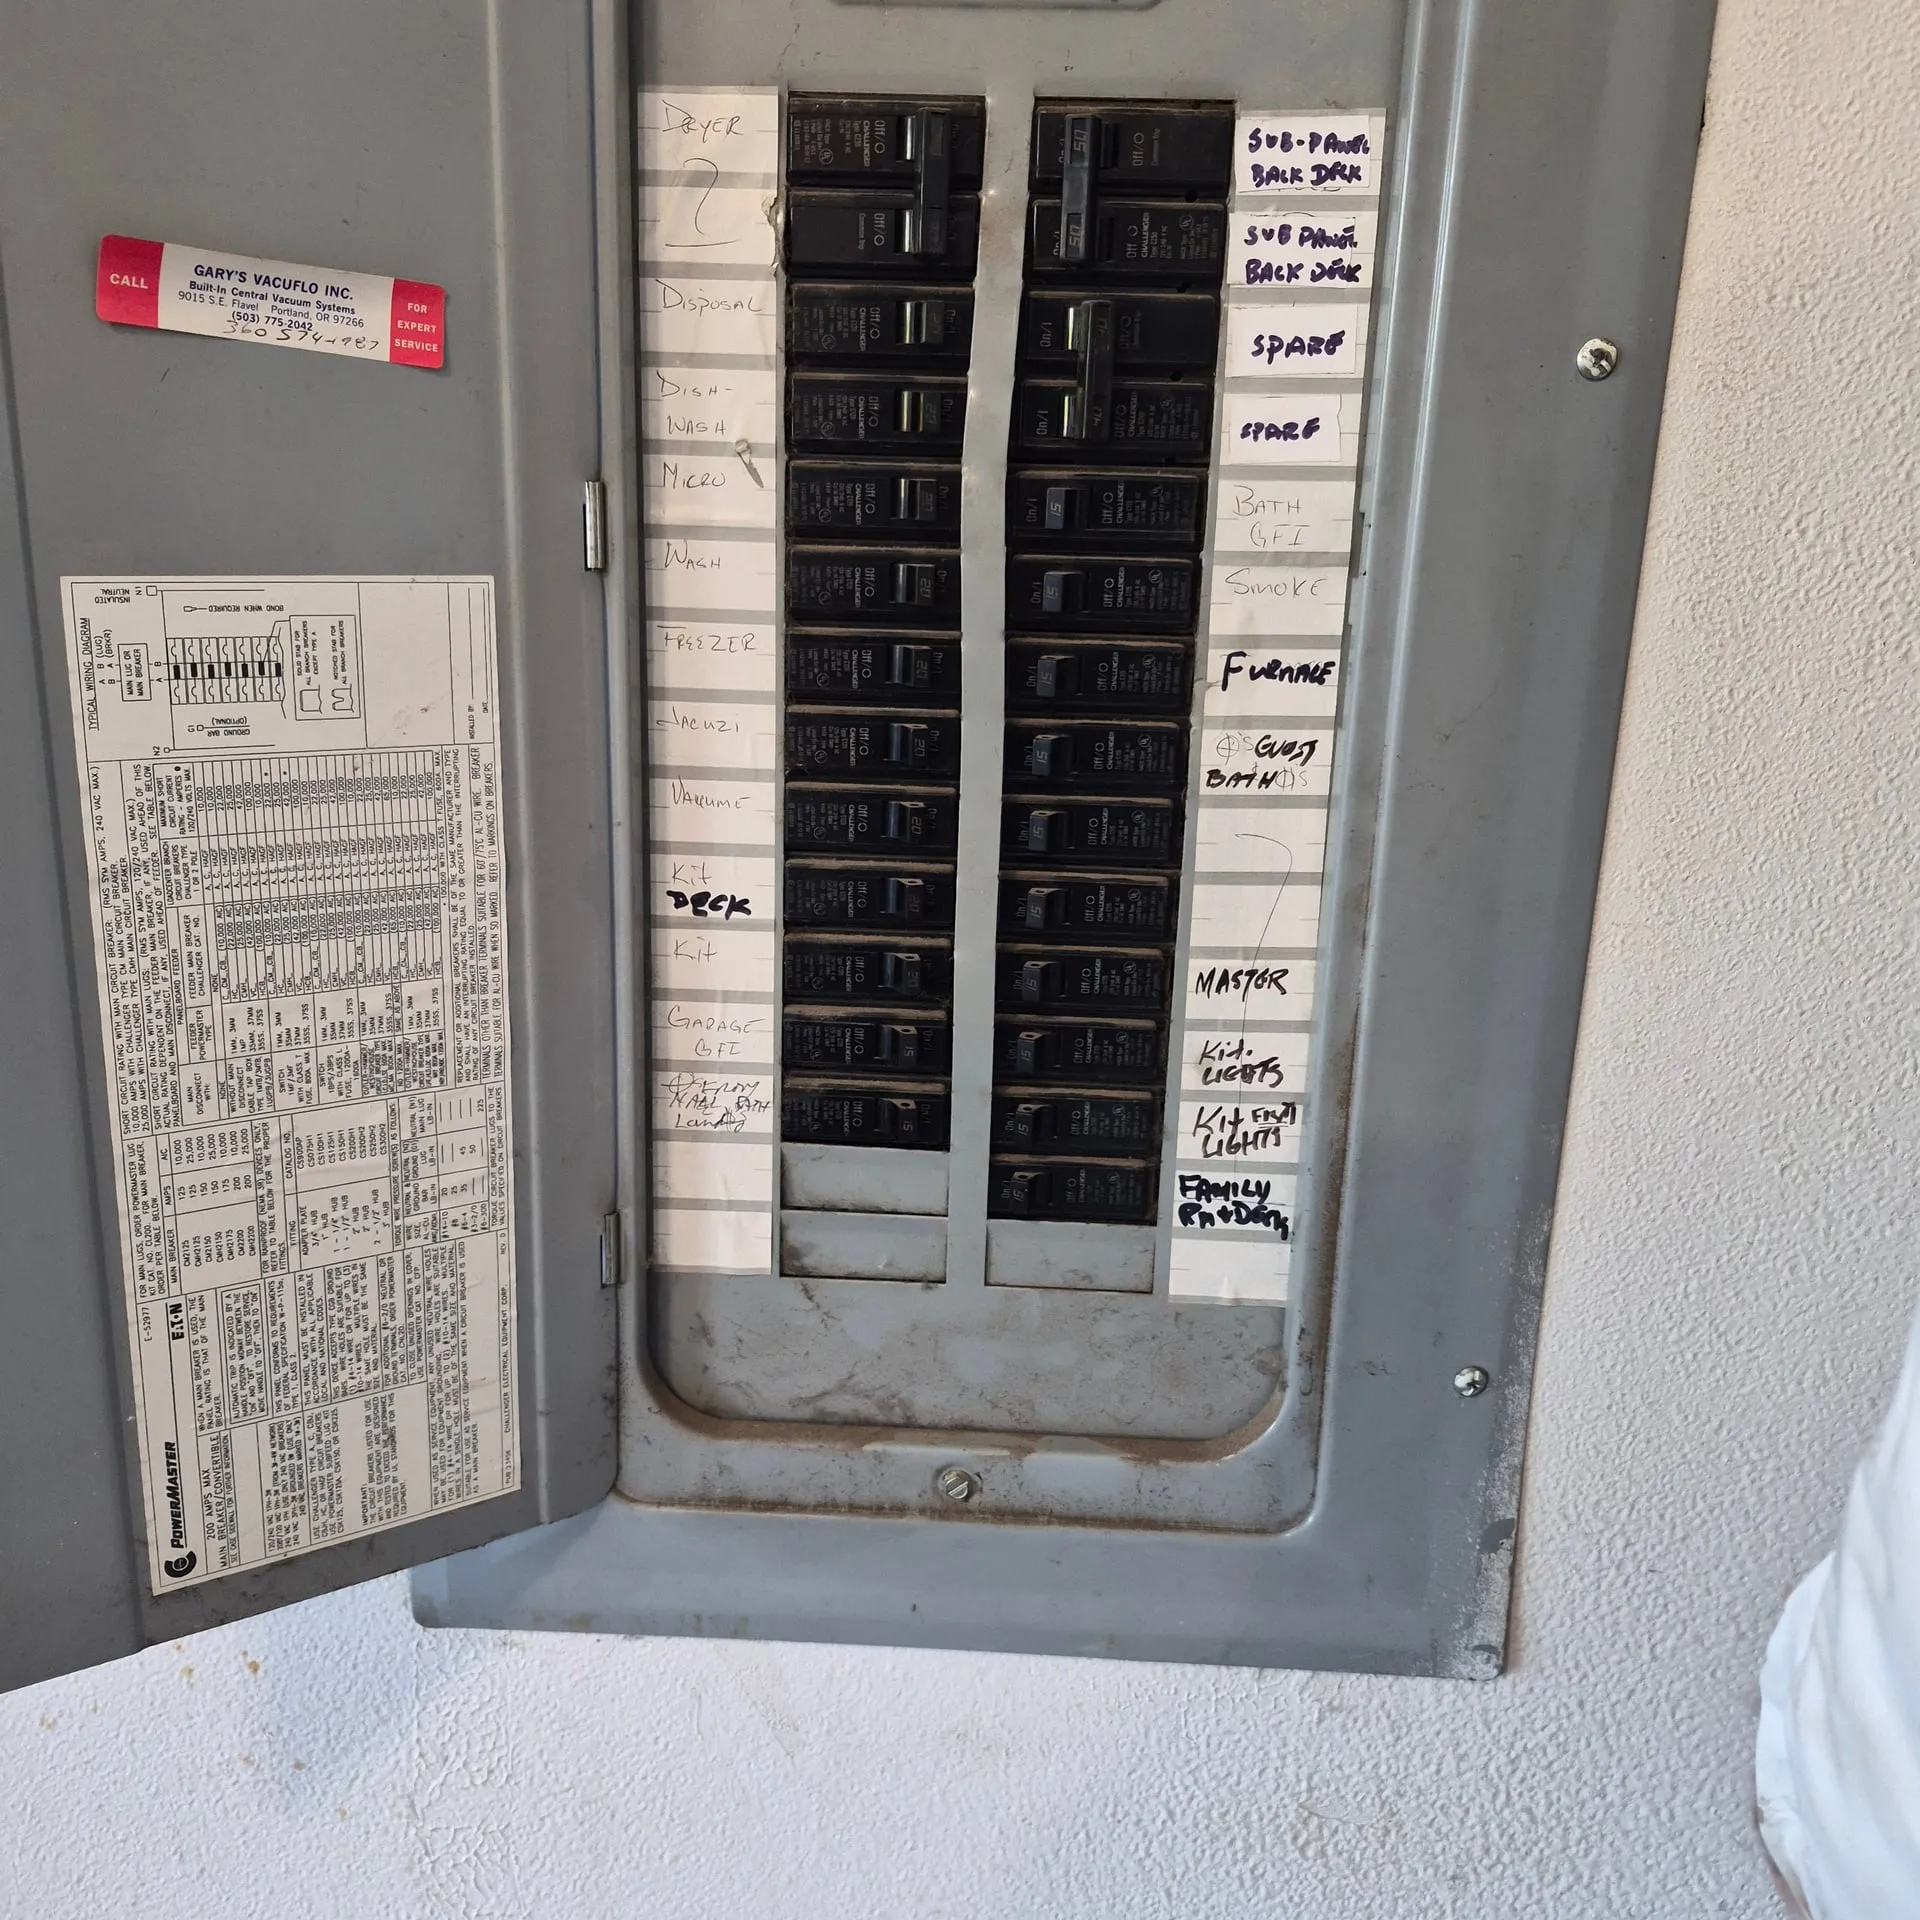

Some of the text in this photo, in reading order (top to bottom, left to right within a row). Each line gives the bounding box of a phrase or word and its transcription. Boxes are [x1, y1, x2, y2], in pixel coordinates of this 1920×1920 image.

[662, 99, 743, 143] DRYER
[1073, 129, 1088, 151] 50
[1251, 161, 1362, 188] BACK DECK
[1069, 224, 1081, 248] 50
[1244, 224, 1292, 246] SUB
[1298, 225, 1358, 249] PANEL
[109, 273, 148, 289] CALL
[194, 264, 353, 300] GARY'S VACUFLO INC.
[1245, 258, 1362, 284] BACK DECK
[178, 290, 364, 328] 9015 S.E. Flavel Portland, OR 97266
[189, 281, 356, 315] Built-In Central Vacuum Systems
[407, 303, 427, 314] FOR
[223, 320, 267, 337] 360
[232, 311, 313, 332] (503) 775-2042
[397, 320, 437, 335] EXPERT
[394, 338, 439, 352] SERVICE
[1251, 330, 1346, 365] SPARE
[667, 415, 726, 435] WASH
[1240, 417, 1320, 442] SPARE
[663, 461, 726, 489] MICRO
[1050, 501, 1062, 516] 15
[1232, 485, 1302, 517] BATH
[1250, 521, 1311, 548] GFI
[664, 538, 721, 571] WASH
[94, 596, 131, 604] INSULATED
[920, 578, 932, 598] 20
[1046, 587, 1058, 600] 15
[93, 635, 104, 658] (LUG)
[103, 629, 114, 658] (BRKR)
[656, 625, 758, 653] FREEZER
[80, 617, 97, 731] TYPICAL WIRING DIAGRAM
[123, 651, 133, 695] MAIN LUG OR
[133, 648, 144, 696] MAIN BREAKER
[1038, 672, 1052, 684] 15
[1036, 751, 1048, 763] 15
[1206, 768, 1278, 789] BATH
[90, 766, 113, 909] (RMS SYM AMPS, 240 VAC MAX.)
[911, 816, 923, 835] 20
[1032, 826, 1044, 839] 15
[666, 890, 752, 920] DECK
[1031, 906, 1042, 918] 15
[171, 948, 184, 1025] PANELBOARD FEEDER
[1025, 978, 1037, 991] 15
[1195, 967, 1289, 1002] MASTER
[105, 920, 131, 1135] SHORT CIRCUIT RATING WITH MAIN CIRCUIT BREAKER:
[479, 966, 492, 1079] TERMINALS OTHER THAN BREAKER
[667, 1005, 766, 1033] GARAGE
[189, 1023, 197, 1050] FEEDER
[196, 1010, 206, 1060] POWERMASTER
[695, 1038, 741, 1058] GFI
[1021, 1049, 1032, 1061] 15
[1018, 1123, 1030, 1136] 15
[1202, 1126, 1281, 1158] LIGHTS
[160, 1148, 168, 1161] AIC
[174, 1139, 183, 1165] 10,000
[230, 1130, 239, 1156] 10,000
[284, 1131, 294, 1179] CATALOG NO.
[163, 1185, 172, 1206] AMPS
[177, 1186, 186, 1200] 125
[233, 1177, 241, 1191] 200
[1013, 1189, 1024, 1201] 15
[1179, 1174, 1271, 1205] FAMILY
[182, 1239, 191, 1267] CM2125
[192, 1235, 202, 1267] CMH2125
[237, 1229, 245, 1256] CM2200
[167, 1229, 177, 1283] MAIN BREAKER
[142, 1307, 152, 1341] E-52977
[202, 1468, 216, 1540] 200 AMPS MAX
[210, 1435, 228, 1568] MAIN BREAKER/CONVERTIBLE
